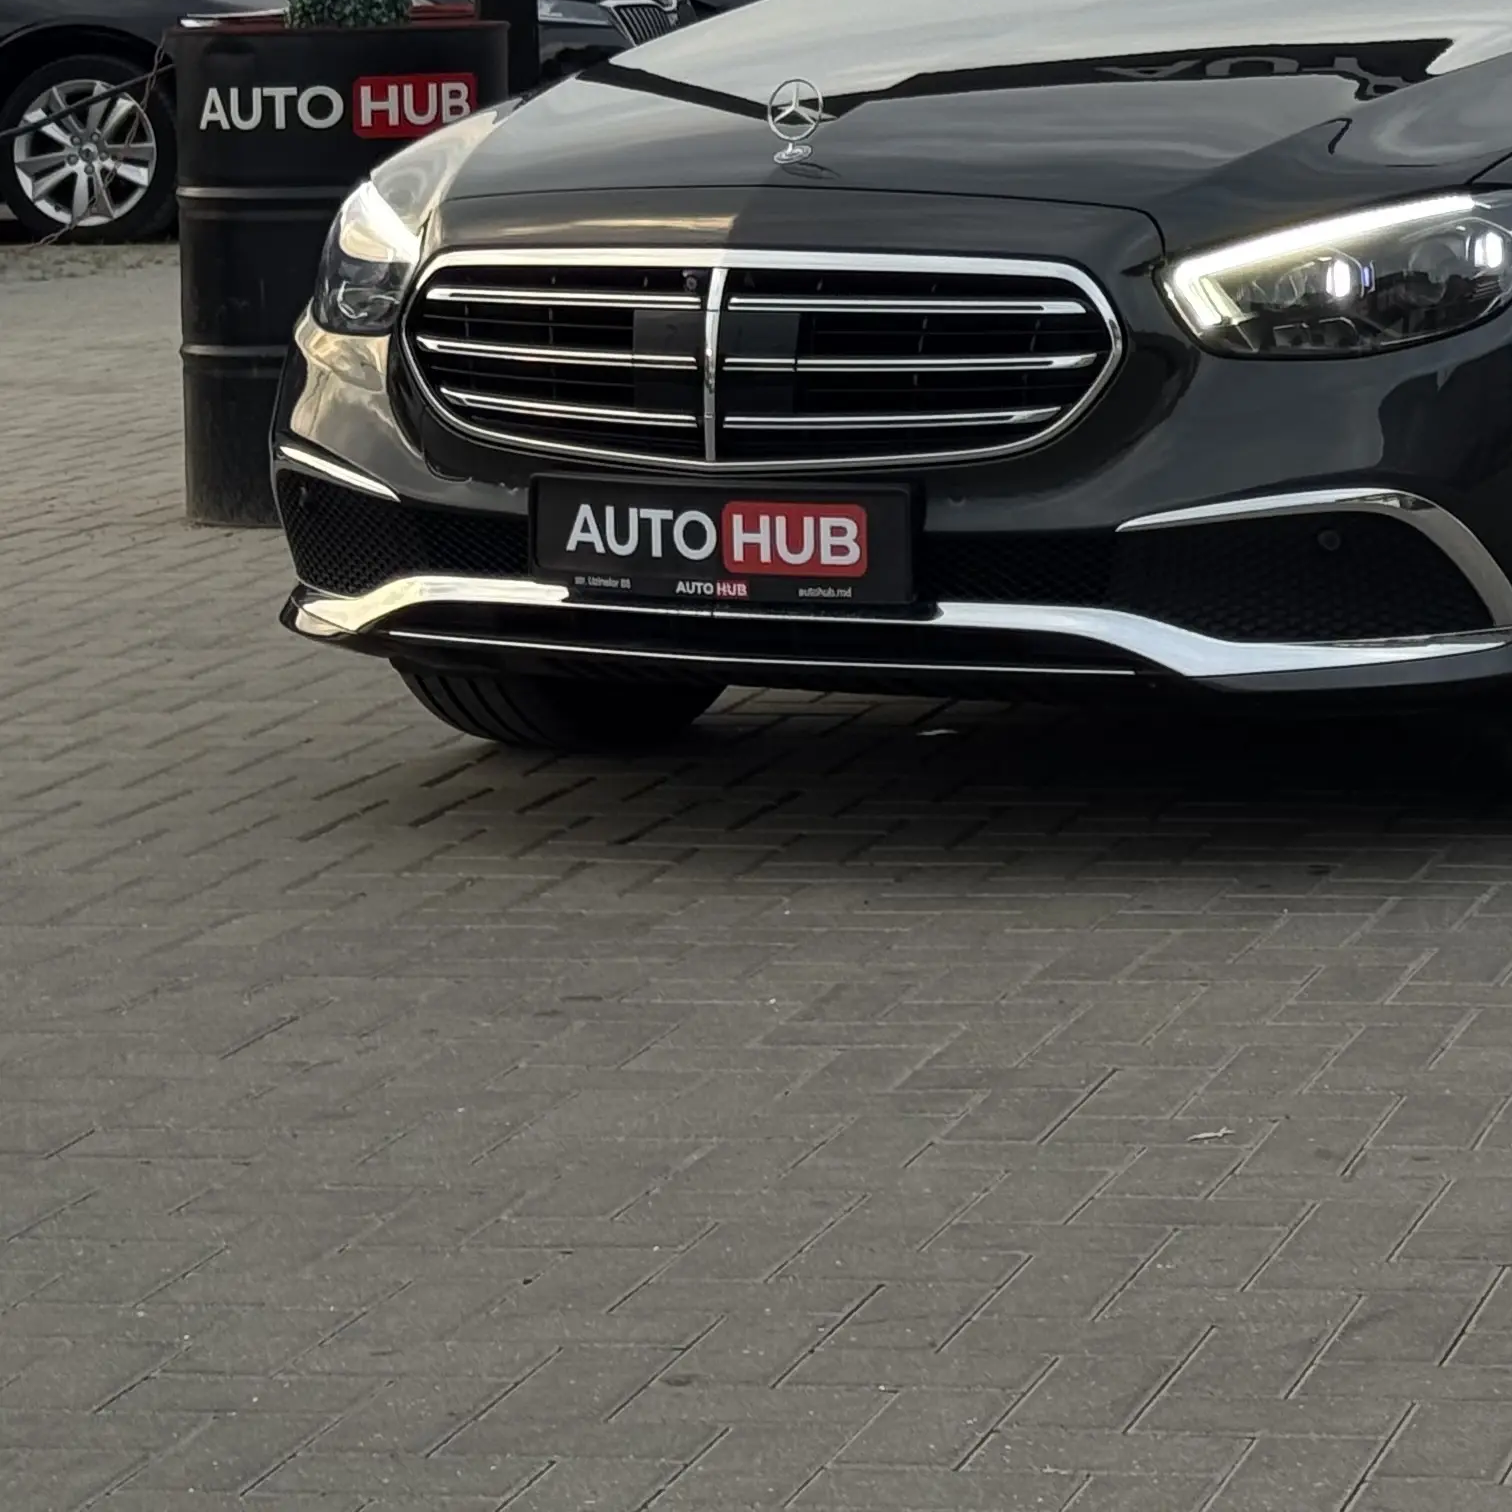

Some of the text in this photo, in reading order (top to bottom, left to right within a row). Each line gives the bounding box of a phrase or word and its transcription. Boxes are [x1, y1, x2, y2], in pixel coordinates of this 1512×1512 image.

[199, 82, 472, 131] AUTO HUB
[566, 503, 862, 566] AUTO HUB
[676, 580, 748, 597] AUTO HUB
